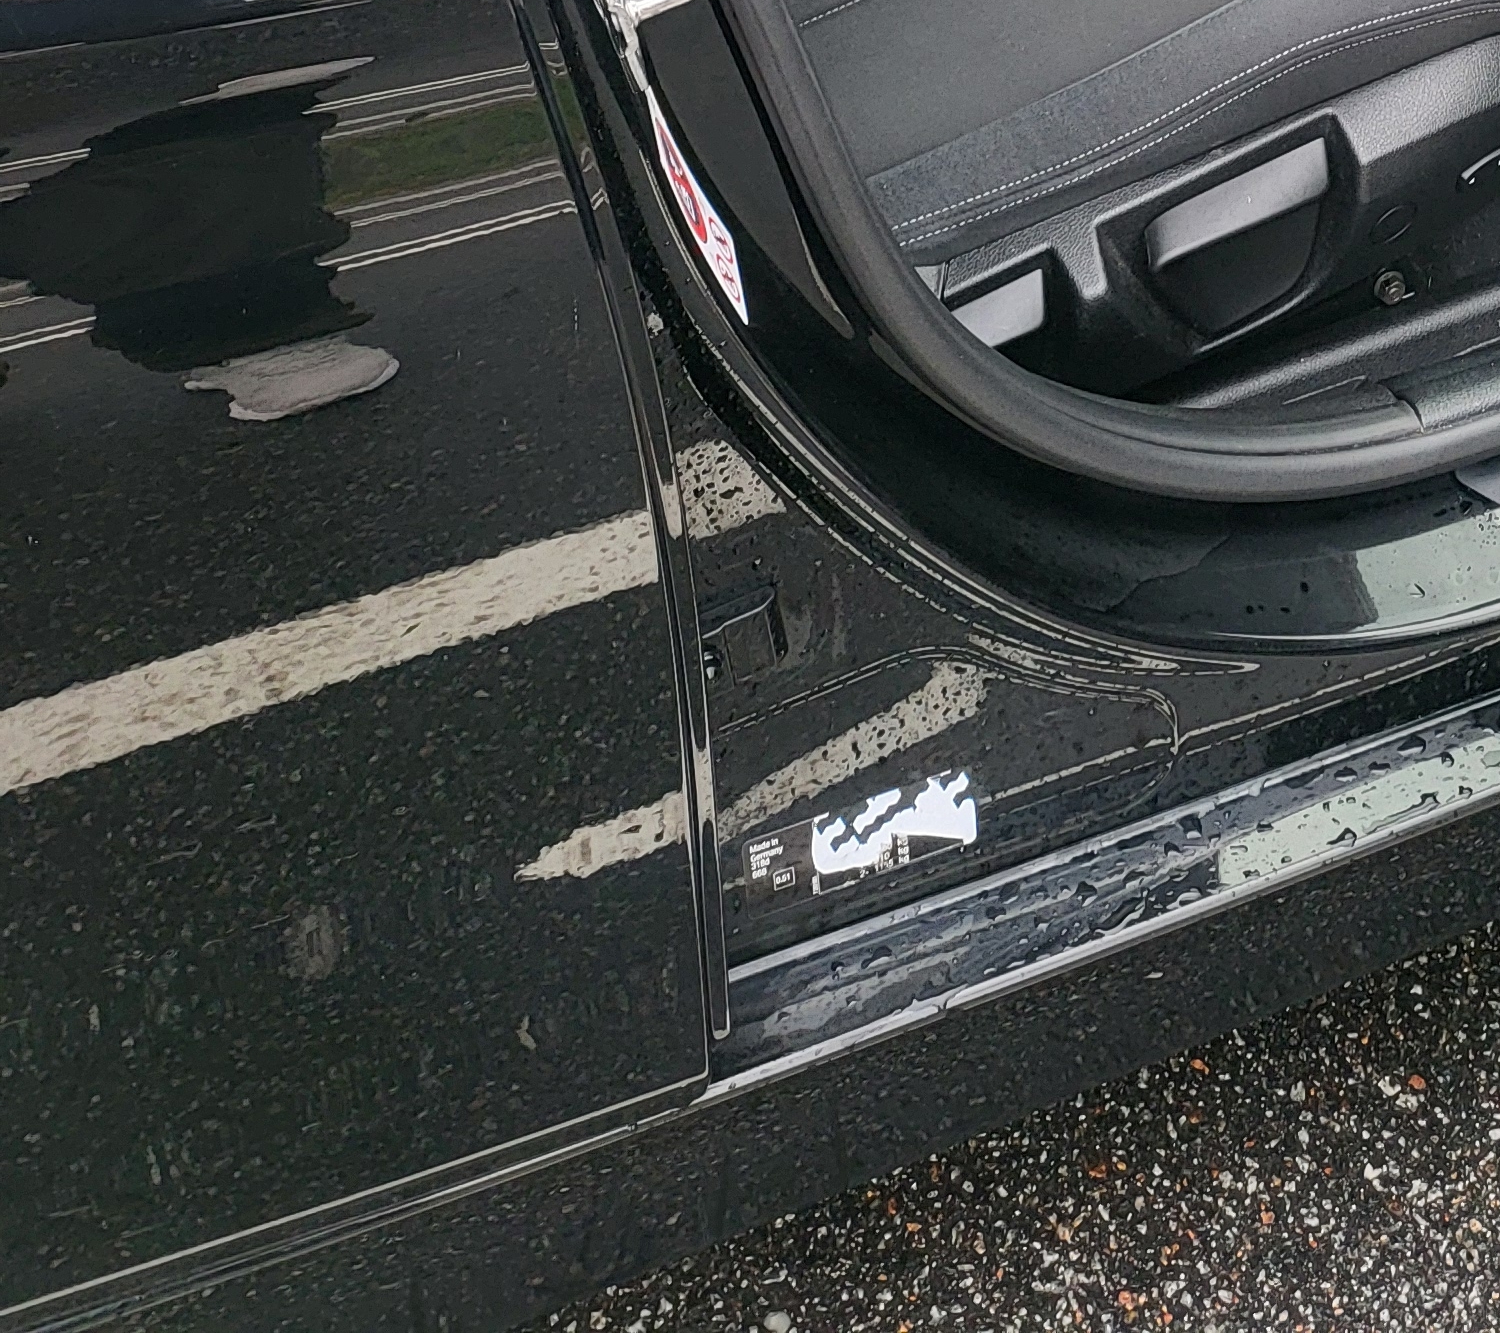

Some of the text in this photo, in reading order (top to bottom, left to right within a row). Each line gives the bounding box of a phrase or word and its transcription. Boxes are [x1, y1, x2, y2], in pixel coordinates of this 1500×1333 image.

[750, 837, 779, 854] Made in
[750, 845, 784, 863] Germany
